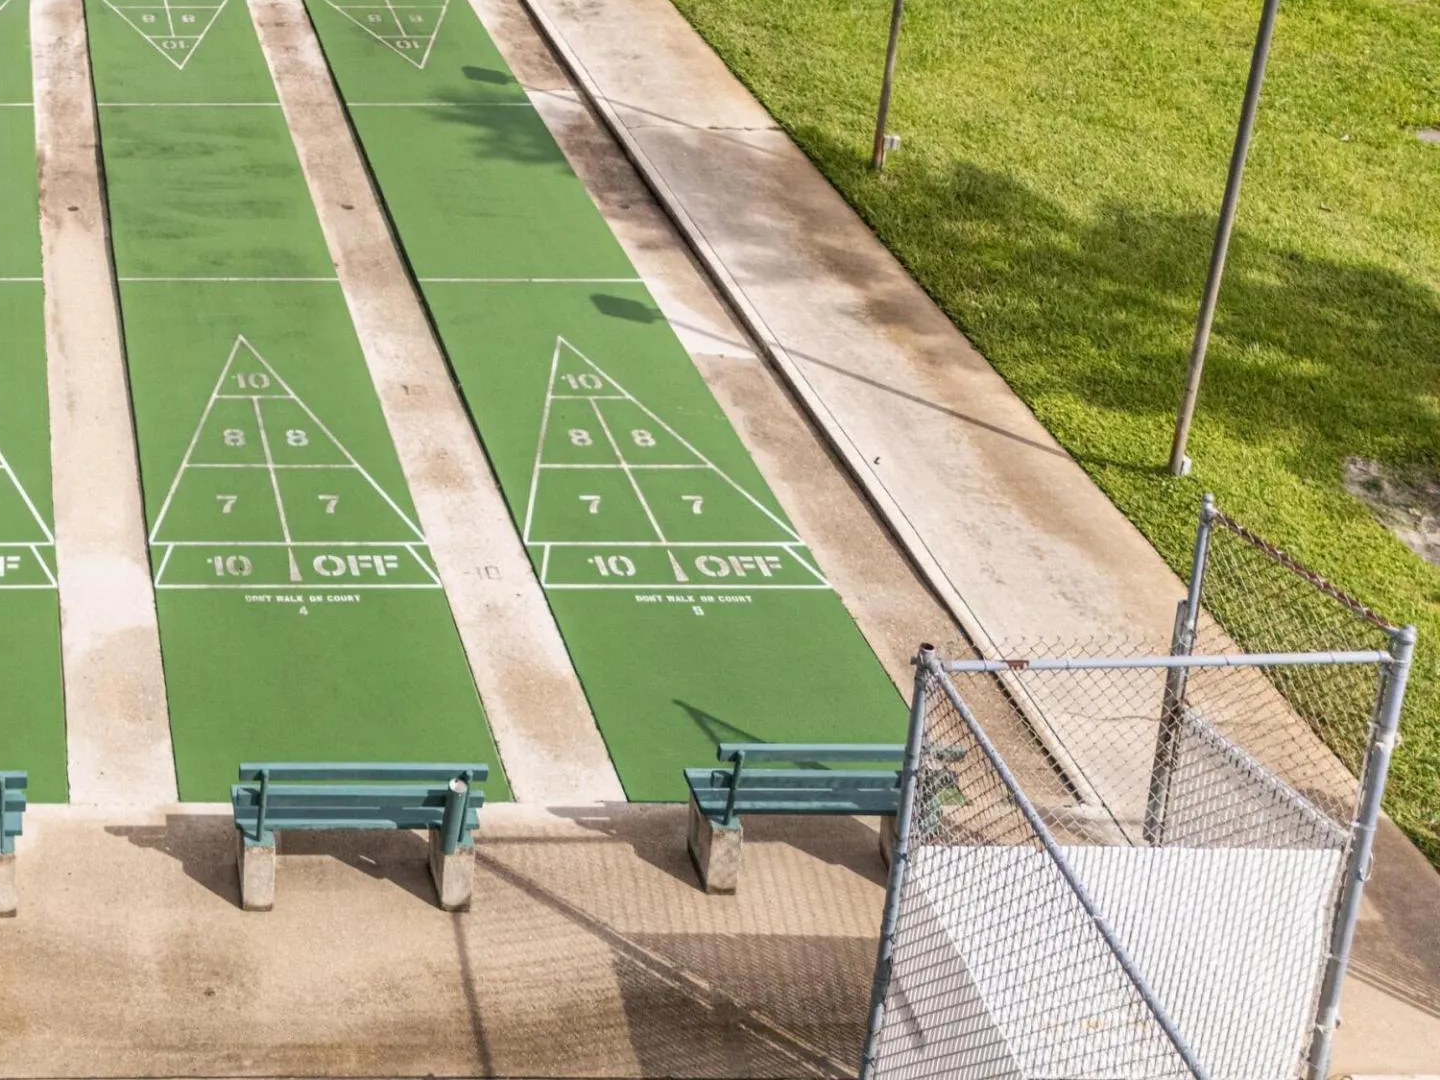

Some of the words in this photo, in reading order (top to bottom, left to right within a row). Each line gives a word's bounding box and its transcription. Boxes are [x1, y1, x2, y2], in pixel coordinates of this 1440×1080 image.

[162, 40, 190, 50] 10
[396, 40, 422, 49] 10
[230, 373, 270, 390] 10
[561, 374, 601, 390] 10
[223, 428, 246, 447] 8
[286, 428, 309, 447] 8
[569, 428, 594, 447] 8
[631, 428, 656, 447] 8
[216, 495, 238, 515] 7
[317, 494, 340, 514] 7
[579, 495, 600, 514] 7
[681, 495, 703, 514] 7
[207, 556, 252, 576] 10
[313, 555, 398, 576] OFF
[587, 556, 636, 576] 10
[695, 555, 782, 577] OFF
[327, 594, 360, 602] COURT
[666, 594, 695, 602] WALK
[718, 594, 752, 602] COURT
[299, 606, 308, 615] 4
